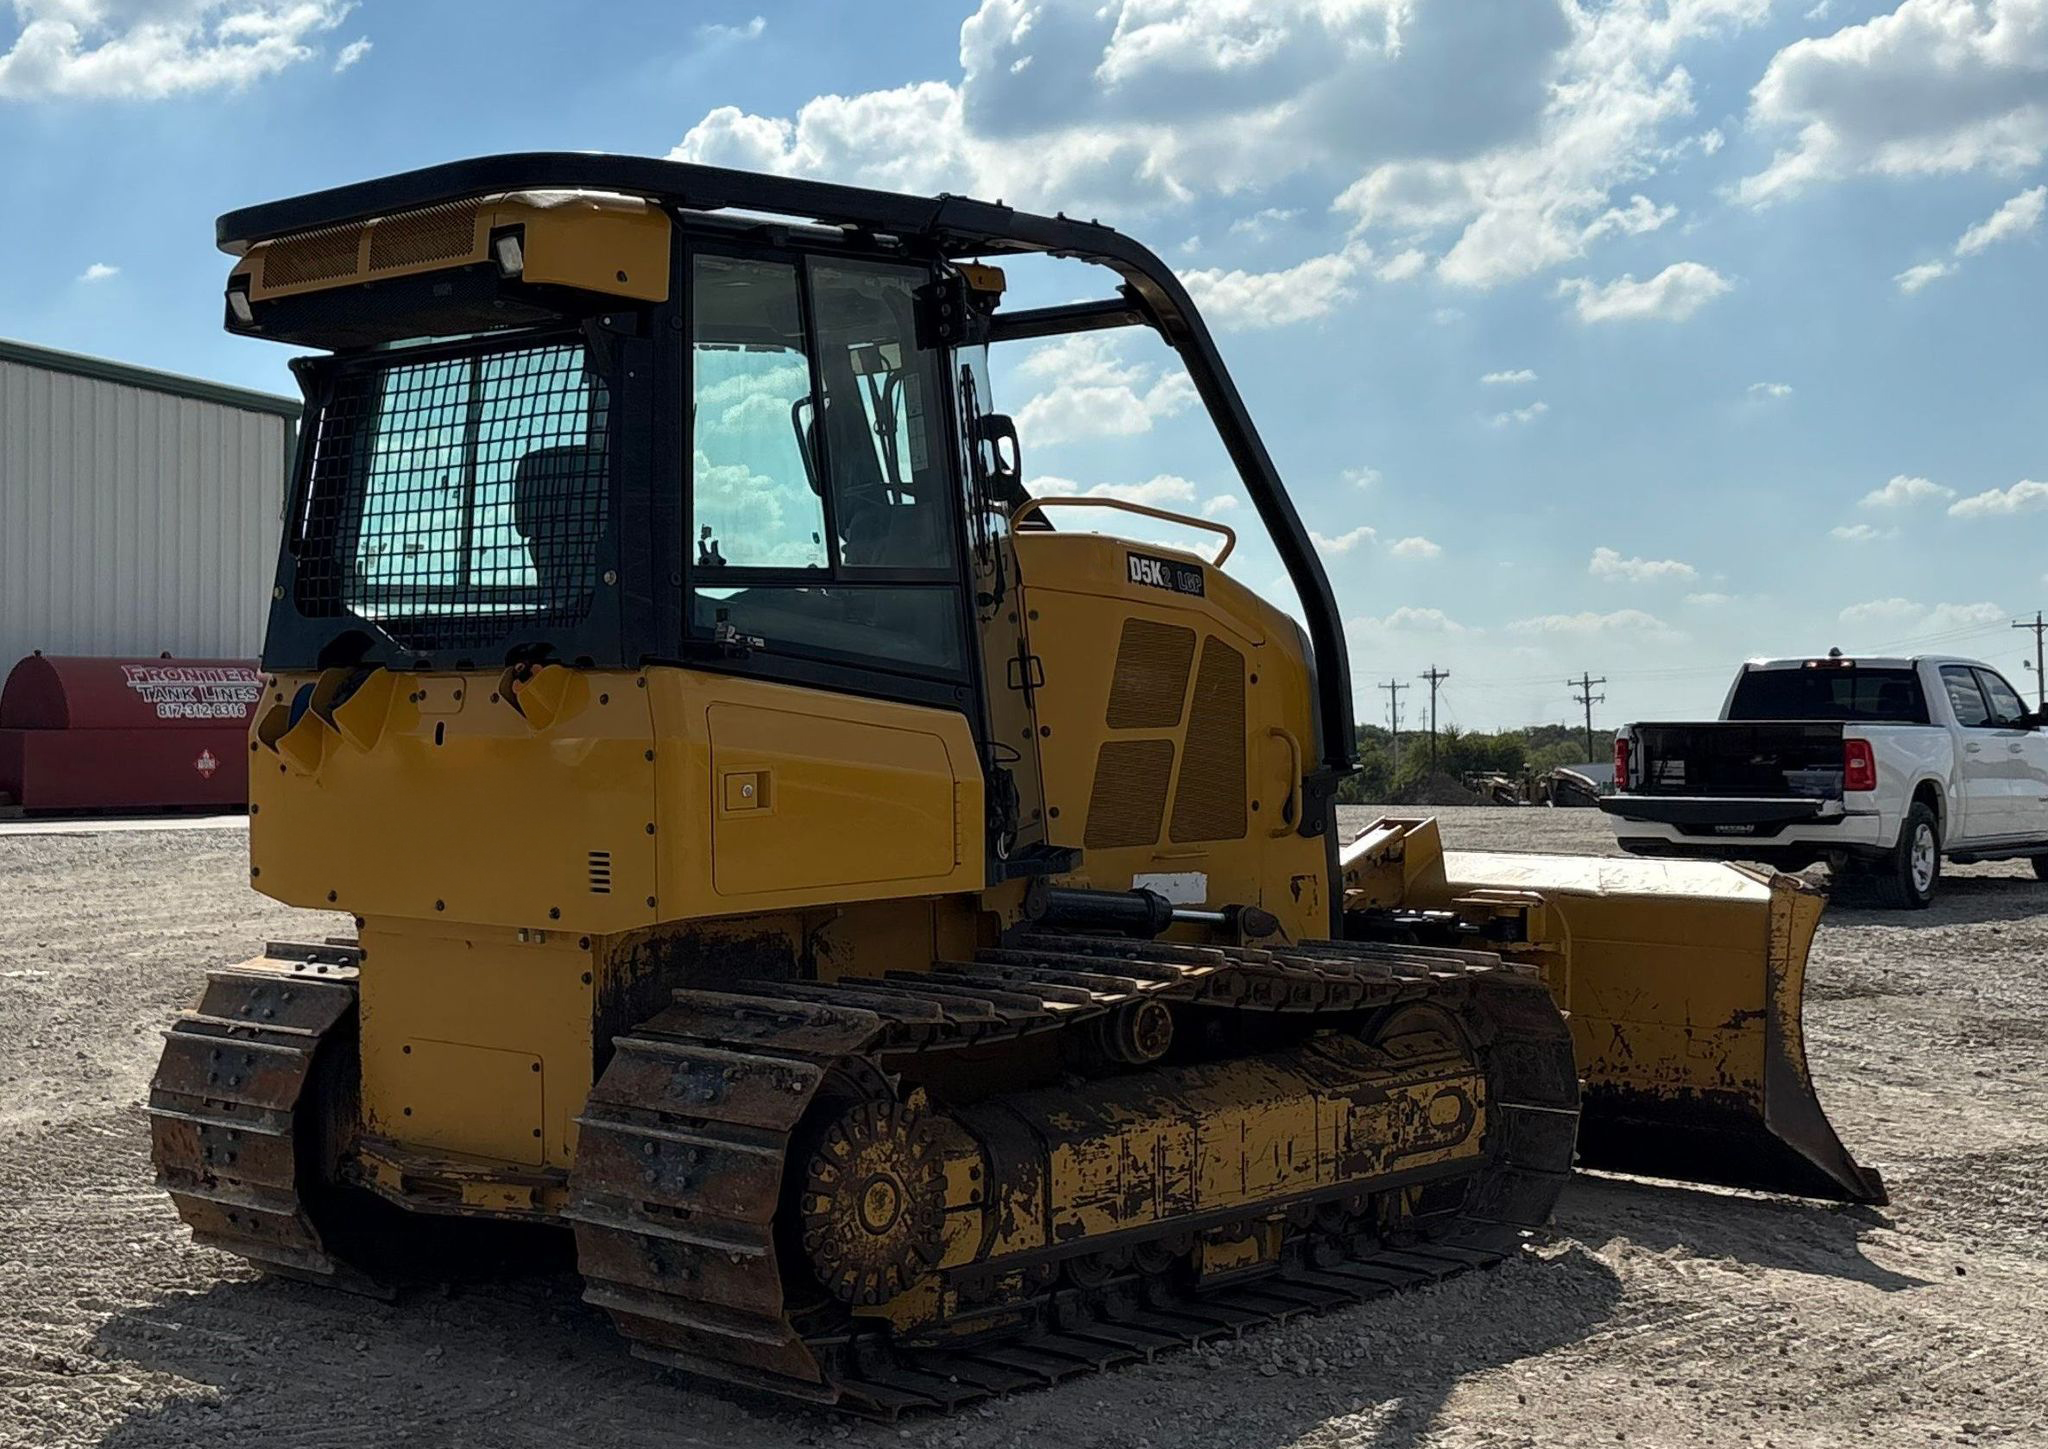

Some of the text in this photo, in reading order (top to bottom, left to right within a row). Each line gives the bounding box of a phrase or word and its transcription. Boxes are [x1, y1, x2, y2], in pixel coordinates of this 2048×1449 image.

[121, 665, 260, 683] FRONTIER
[137, 685, 260, 702] TANK LINES
[157, 703, 246, 718] 817-312-8316
